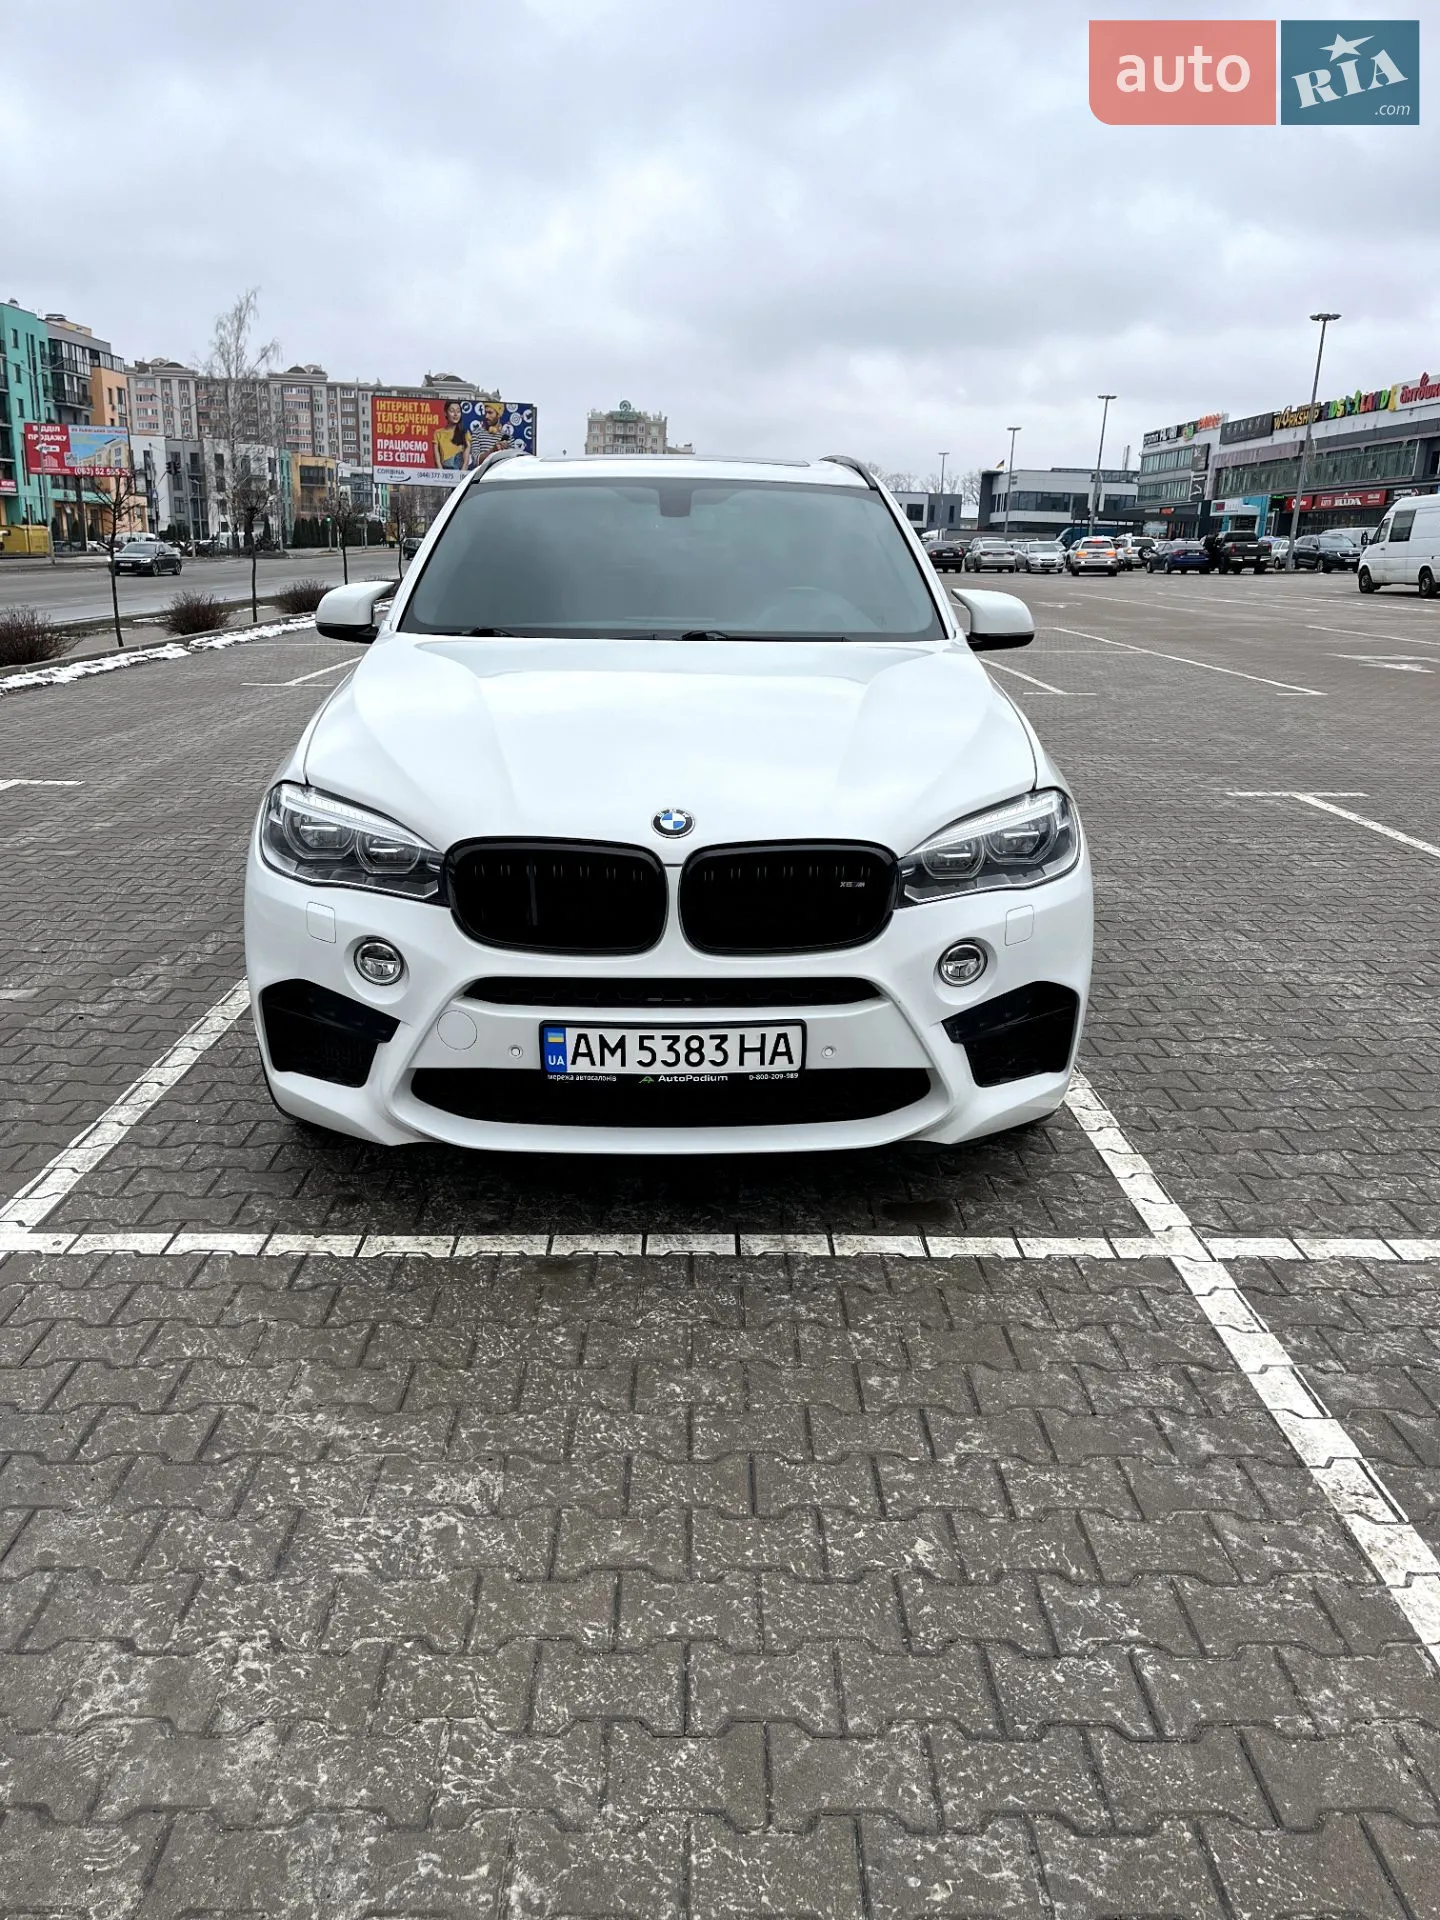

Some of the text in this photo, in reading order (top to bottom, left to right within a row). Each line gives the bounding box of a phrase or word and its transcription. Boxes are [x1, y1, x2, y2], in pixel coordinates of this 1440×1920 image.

[376, 400, 430, 413] ІНТЕРНЕТ ТА
[376, 411, 439, 425] ТЕЛЕБАЧЕННЯ
[1274, 405, 1320, 430] WORKSHP
[32, 425, 60, 433] ВДДІЛ
[376, 423, 393, 435] ВІД
[411, 426, 429, 436] ГРН
[377, 439, 429, 452] ПРАЦЮЄМО
[377, 451, 426, 464] БЕЗ СВІТЛА
[570, 1033, 794, 1068] AM 5383 HA
[548, 1055, 565, 1066] UA
[658, 1074, 728, 1082] AutoPodium
